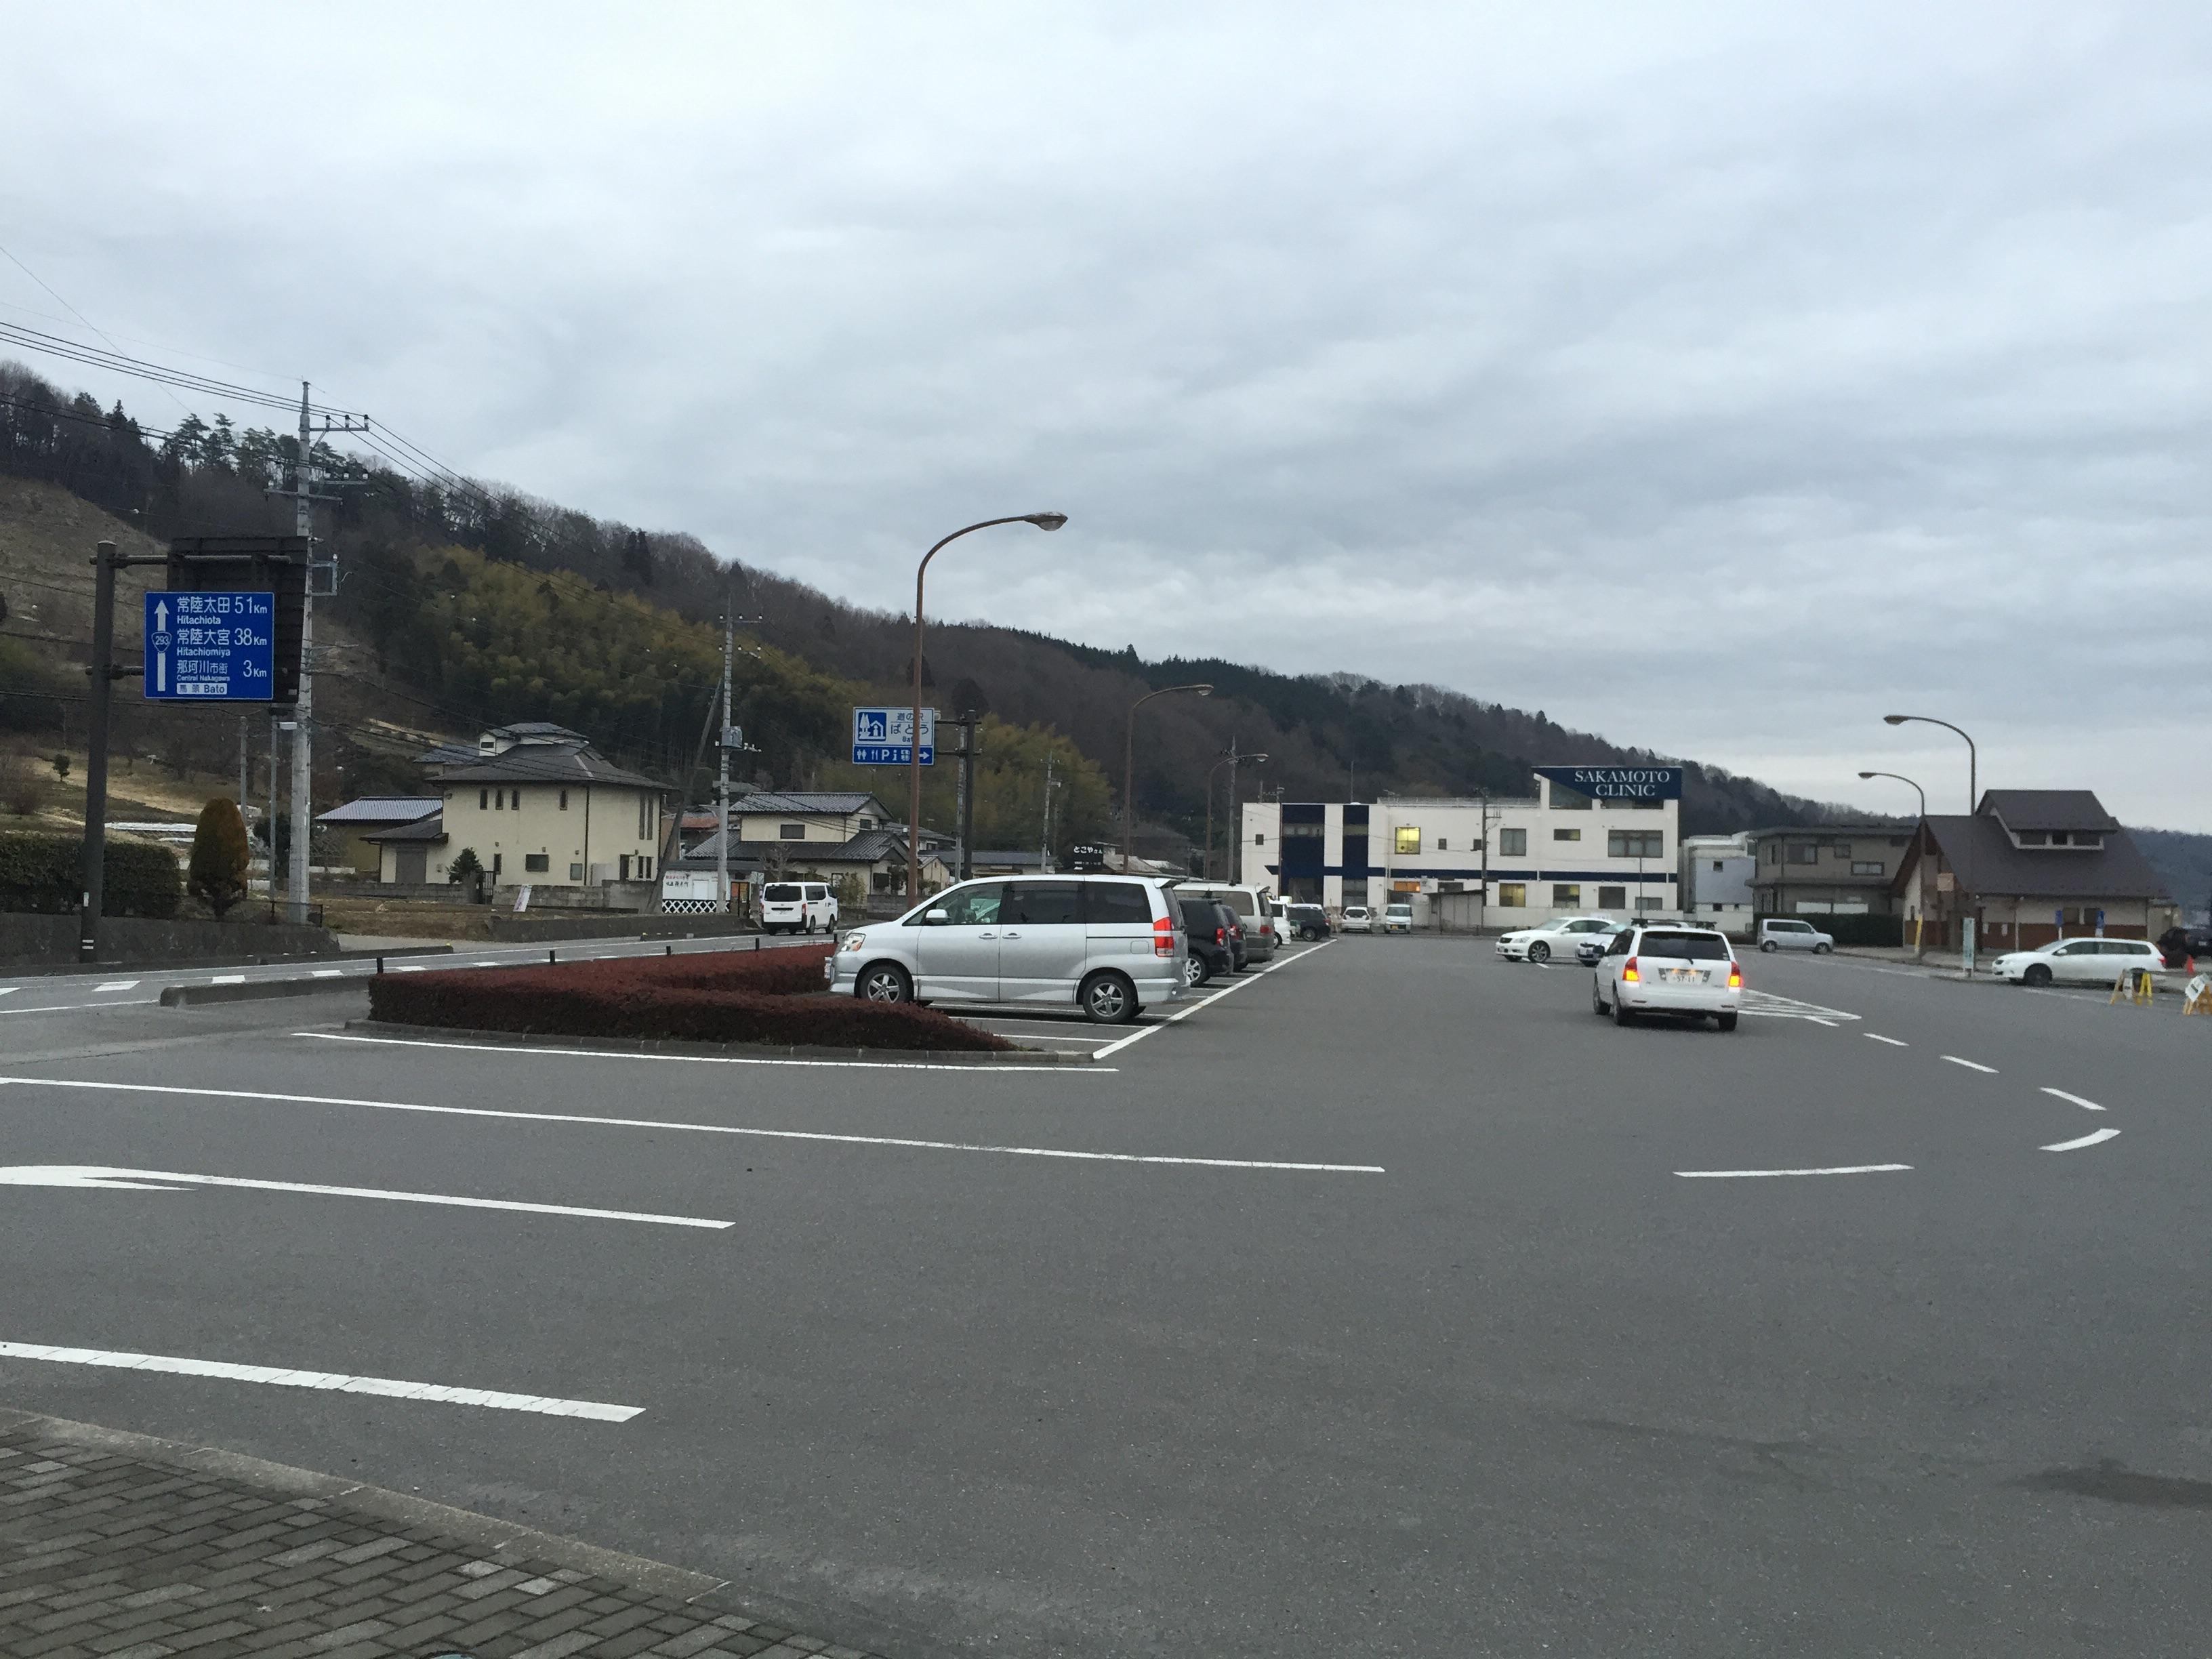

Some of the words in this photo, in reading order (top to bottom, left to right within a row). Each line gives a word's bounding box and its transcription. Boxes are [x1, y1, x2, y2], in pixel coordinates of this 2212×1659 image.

[177, 596, 230, 613] 常陸太田
[177, 615, 221, 624] Hitachiota
[155, 636, 169, 645] 293
[177, 628, 230, 645] 常陸大宮
[177, 647, 230, 657] Hitachiomiya
[204, 684, 225, 693] Bato
[1574, 771, 1670, 783] SAKAMOTO
[1595, 784, 1656, 796] CLINIC
